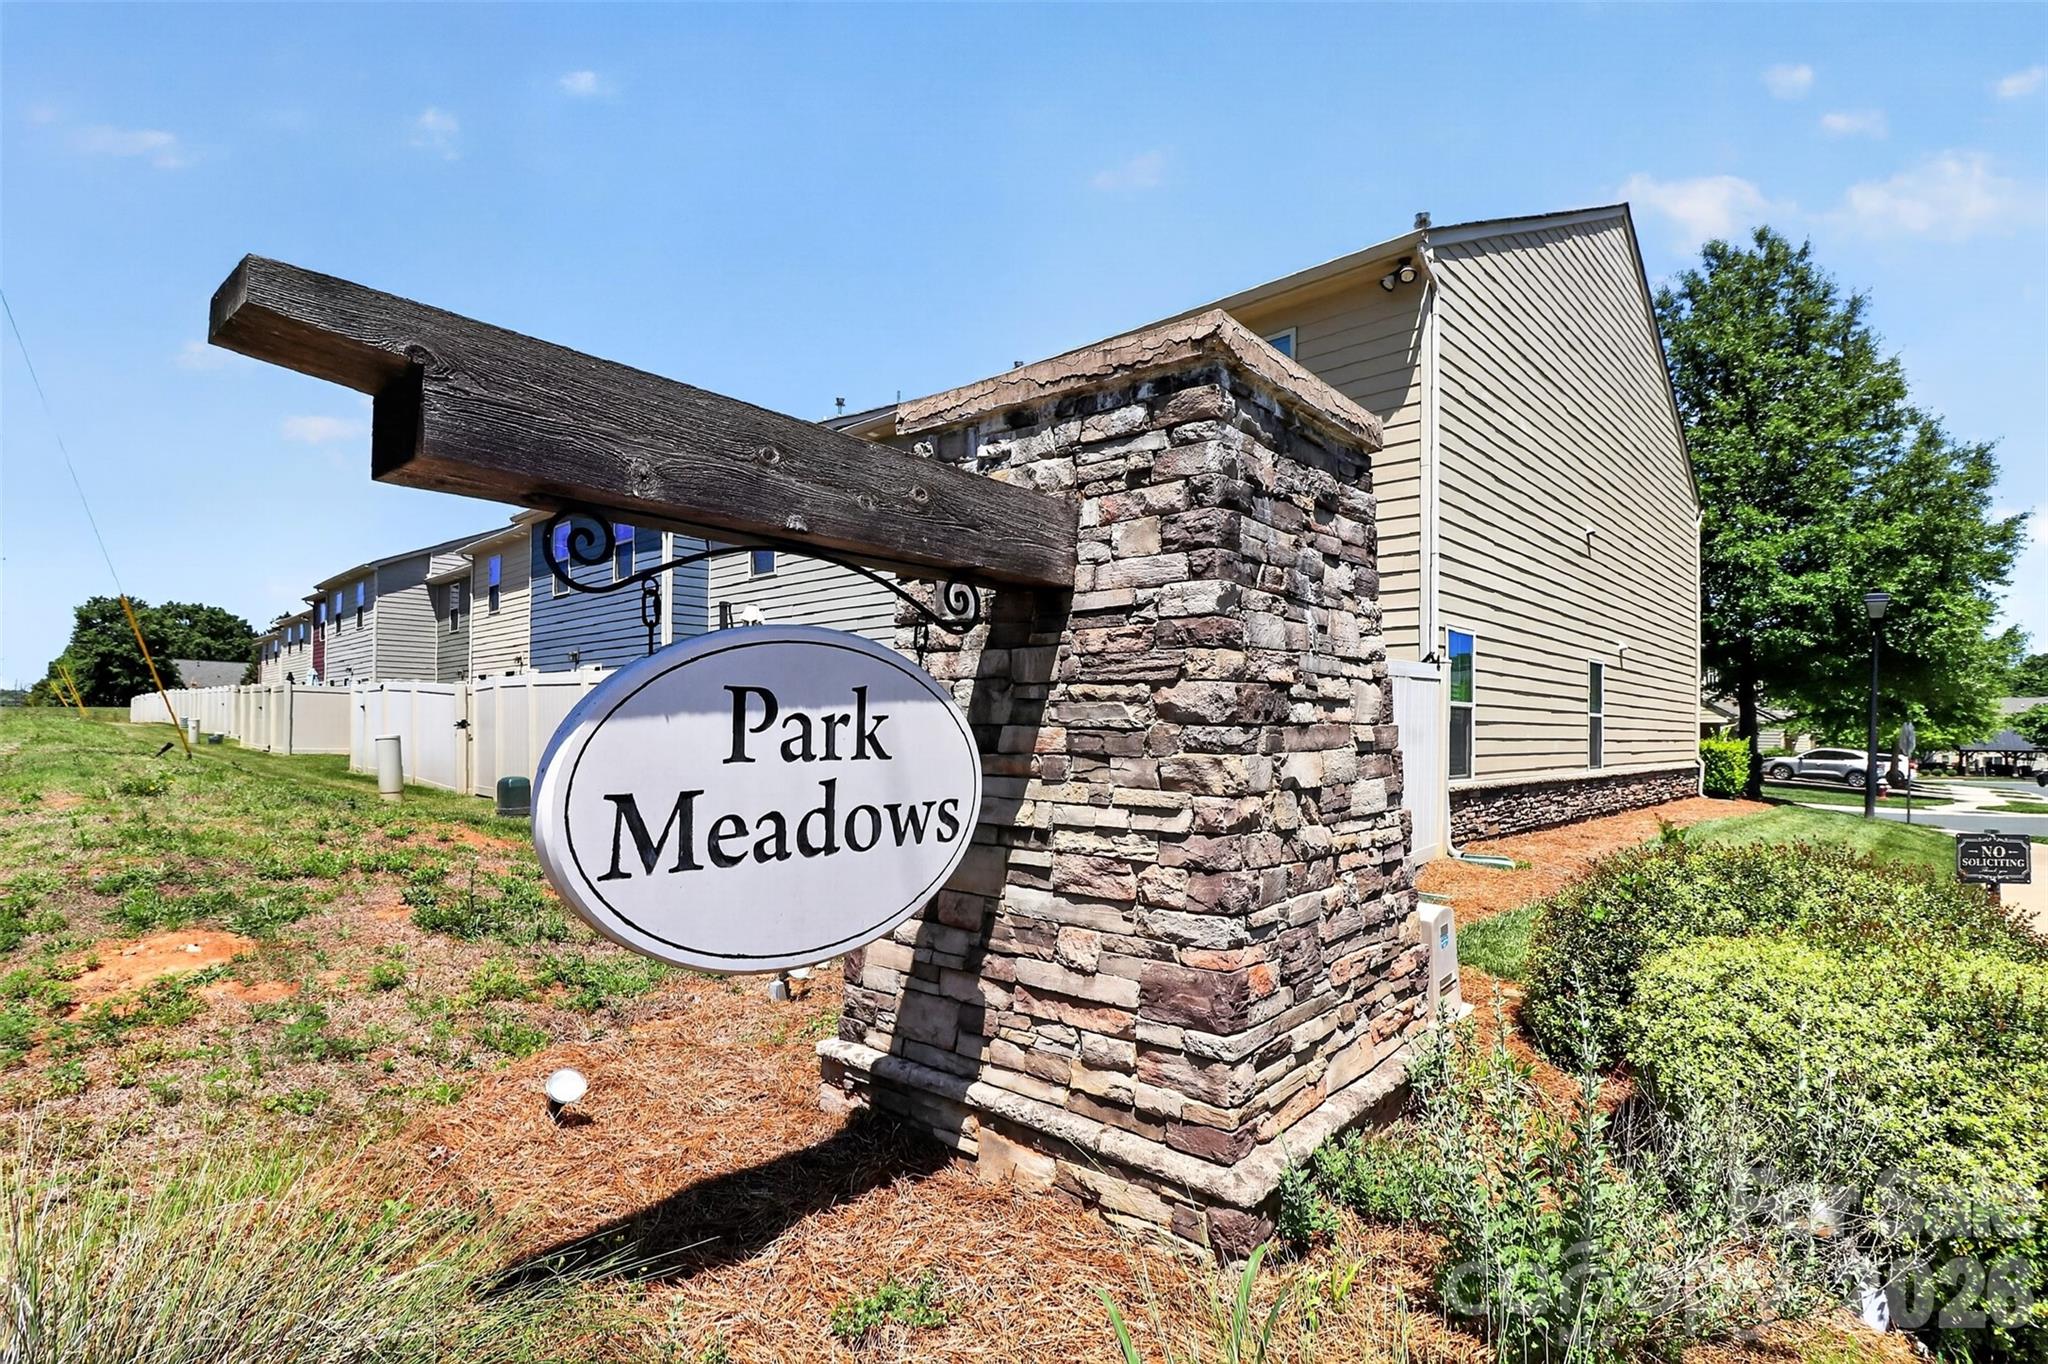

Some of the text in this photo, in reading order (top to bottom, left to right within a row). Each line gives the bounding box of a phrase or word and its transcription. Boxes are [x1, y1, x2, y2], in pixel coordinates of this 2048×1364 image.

[723, 685, 892, 763] Park
[597, 777, 960, 881] Meadows
[1981, 845, 2006, 858] NO
[1962, 858, 2025, 867] SOLICITING
